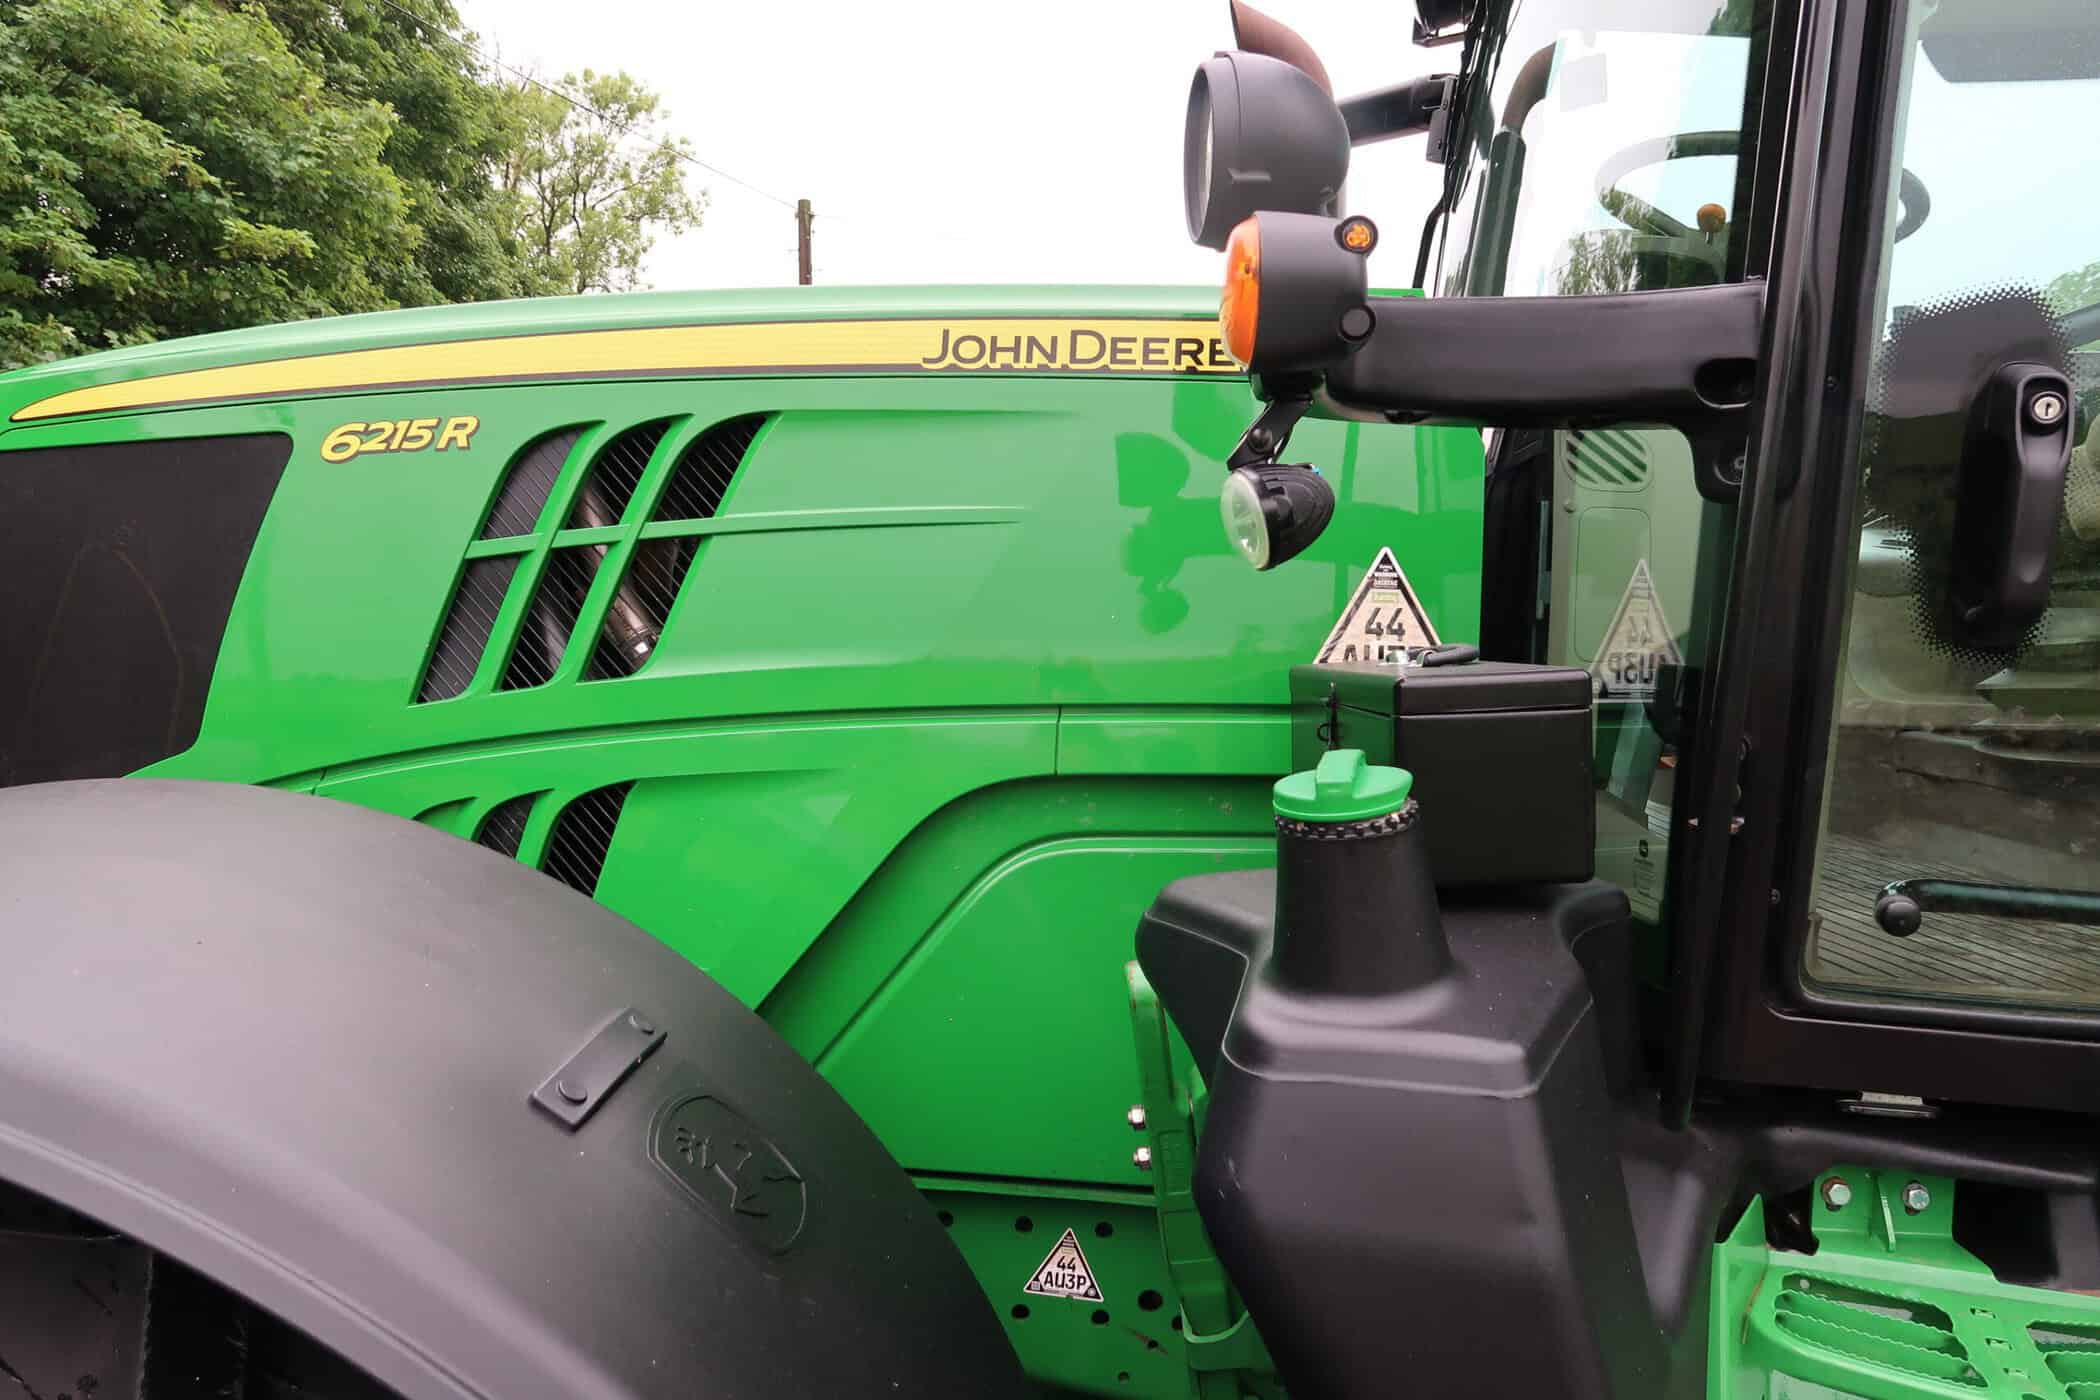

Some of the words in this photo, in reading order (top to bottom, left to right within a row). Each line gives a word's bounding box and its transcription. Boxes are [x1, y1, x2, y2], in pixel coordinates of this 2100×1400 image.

[922, 328, 1058, 365] JOHN
[1365, 607, 1406, 641] 44
[1057, 1256, 1077, 1272] 44
[1044, 1271, 1087, 1290] AU3P
